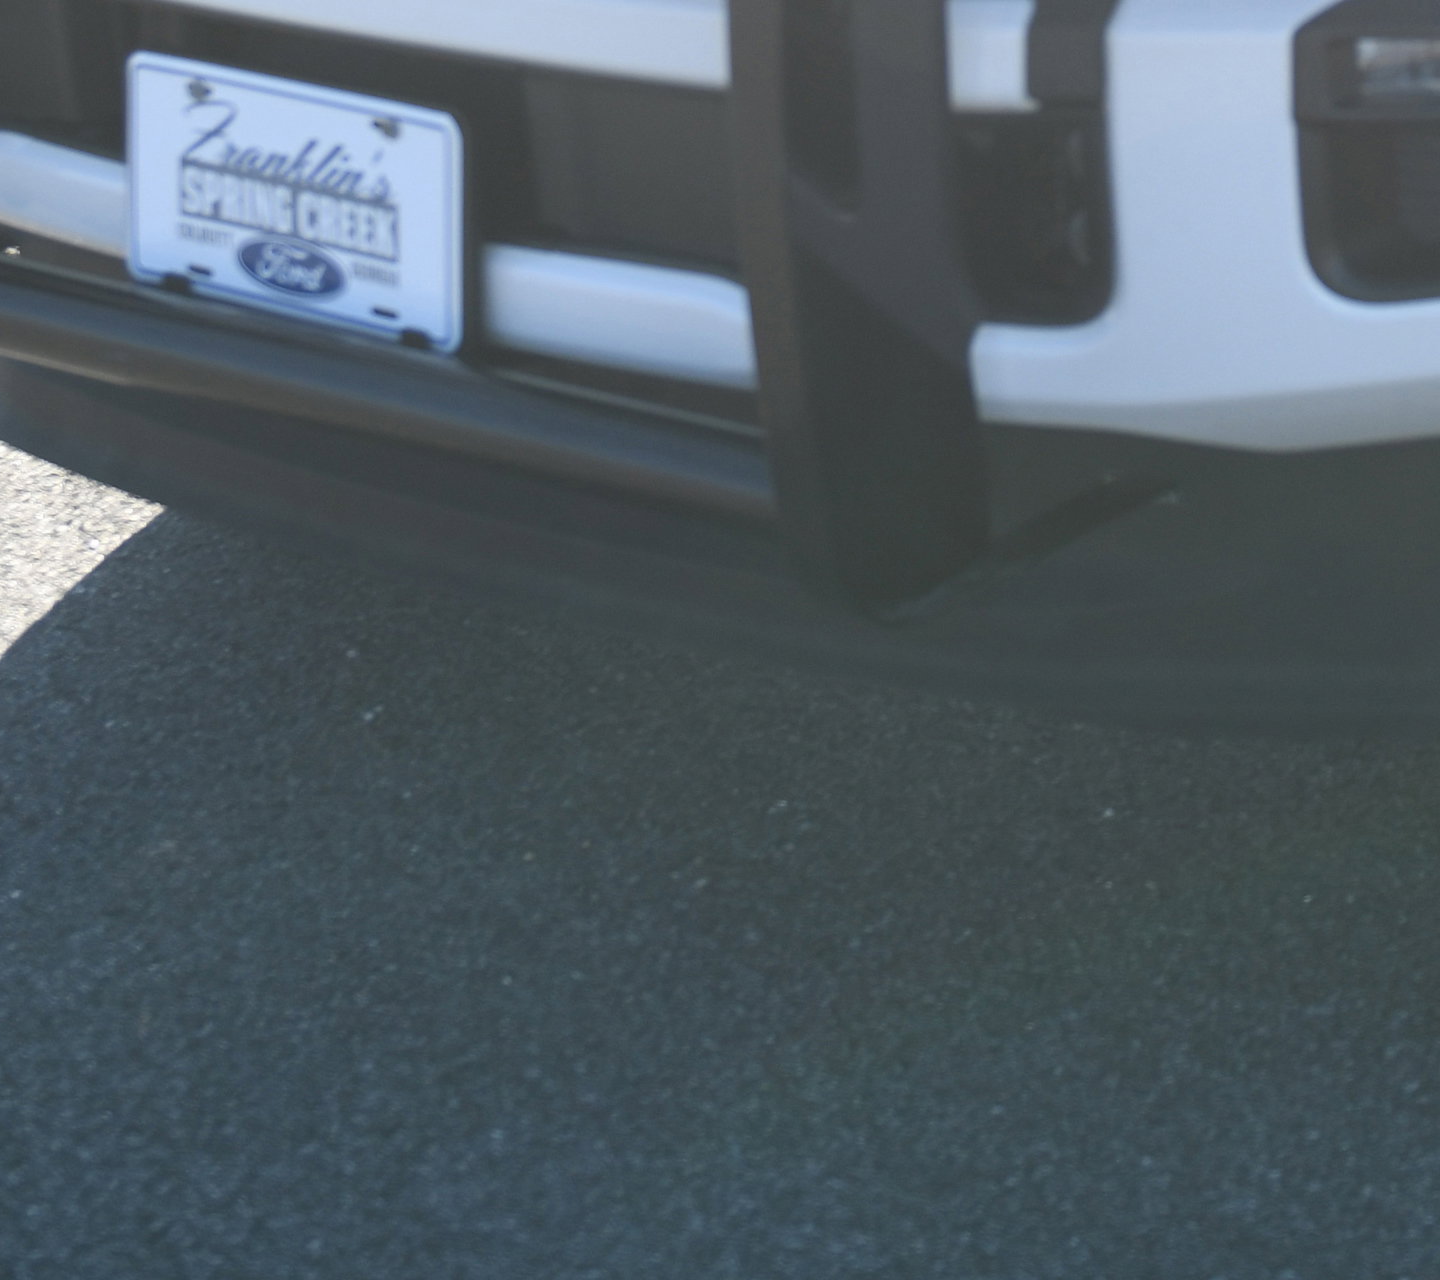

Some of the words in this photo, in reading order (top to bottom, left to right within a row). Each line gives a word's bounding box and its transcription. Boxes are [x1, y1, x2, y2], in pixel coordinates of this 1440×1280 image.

[182, 162, 293, 233] SPRING
[297, 189, 396, 258] CREEK
[254, 238, 327, 291] Ford
